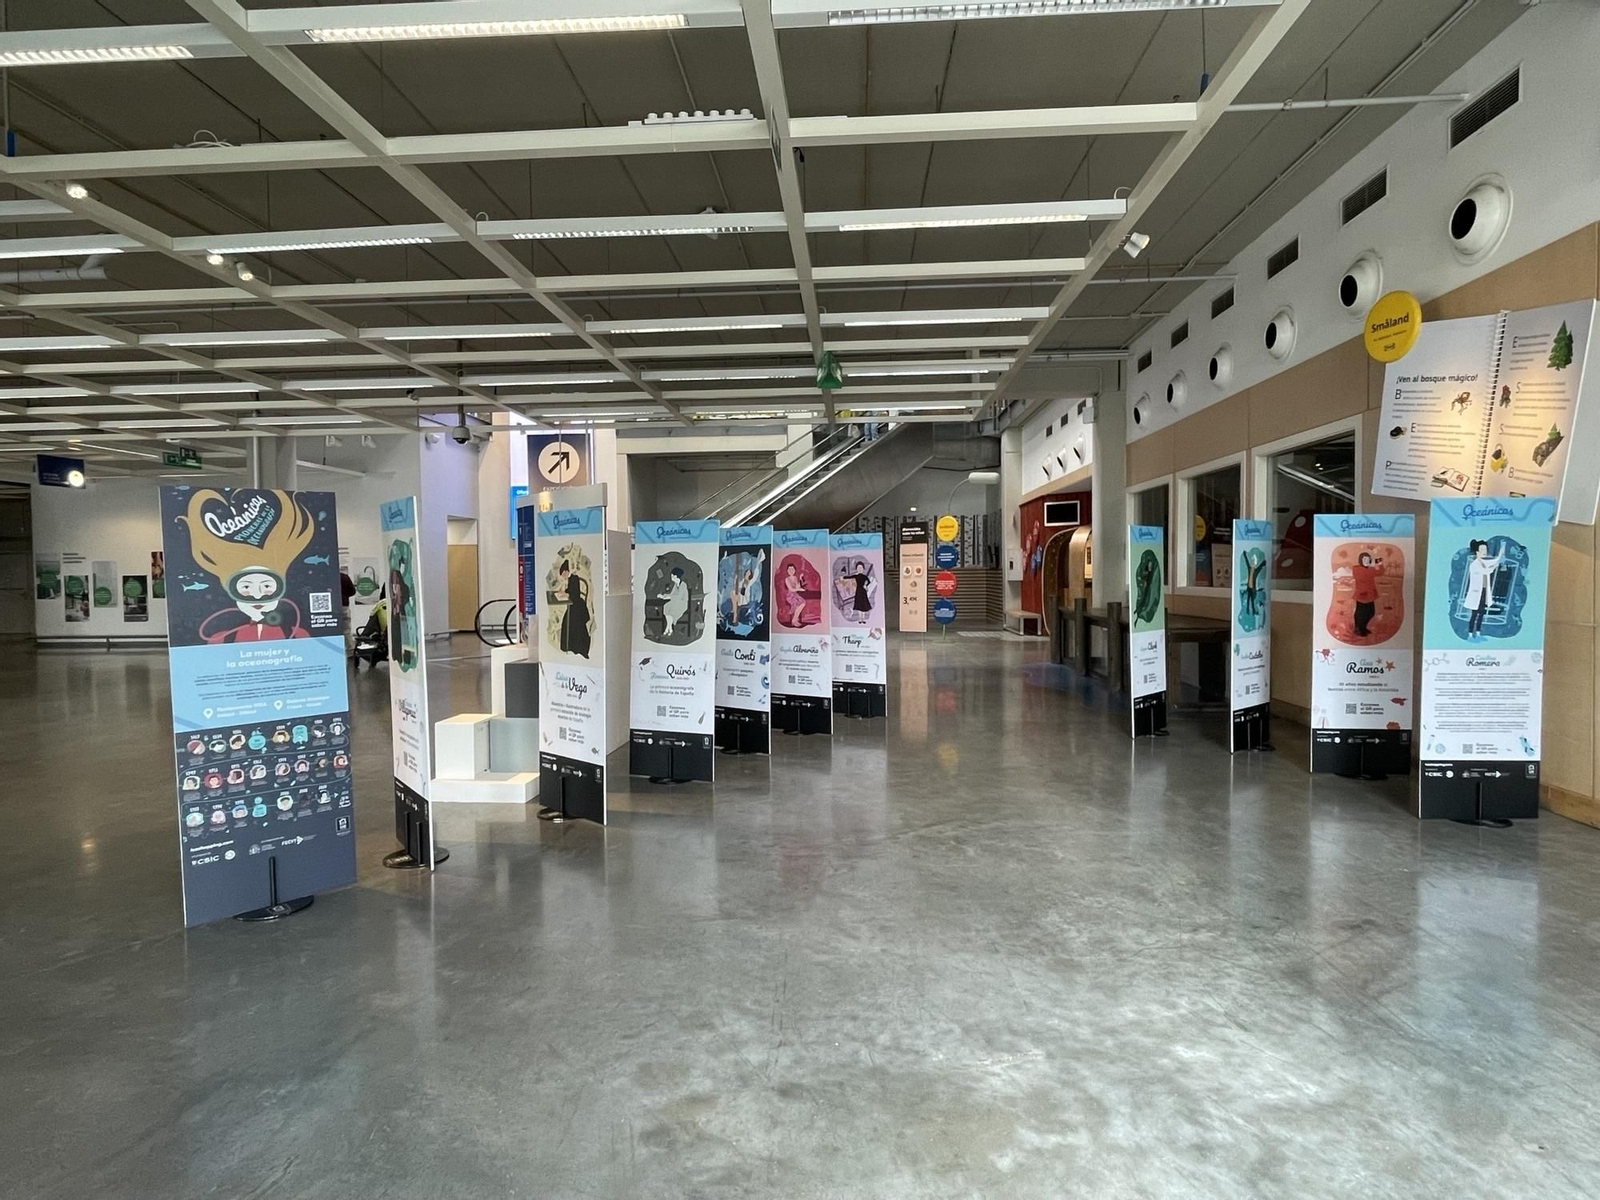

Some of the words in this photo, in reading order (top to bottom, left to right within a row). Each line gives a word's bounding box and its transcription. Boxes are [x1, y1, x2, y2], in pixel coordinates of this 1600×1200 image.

[1371, 312, 1410, 333] Småland
[1412, 375, 1420, 383] al
[1420, 374, 1447, 384] bosque
[1448, 373, 1479, 384] mágico!
[204, 495, 267, 537] Oceánicas
[1462, 505, 1514, 520] Oceánicas
[1340, 519, 1383, 532] Oceánicas
[254, 648, 282, 658] mujer
[283, 648, 290, 656] y
[734, 648, 756, 661] Conti
[666, 664, 696, 679] Quirós
[1346, 661, 1385, 674] Ramos
[568, 677, 588, 700] Vega
[197, 855, 220, 865] CSIC
